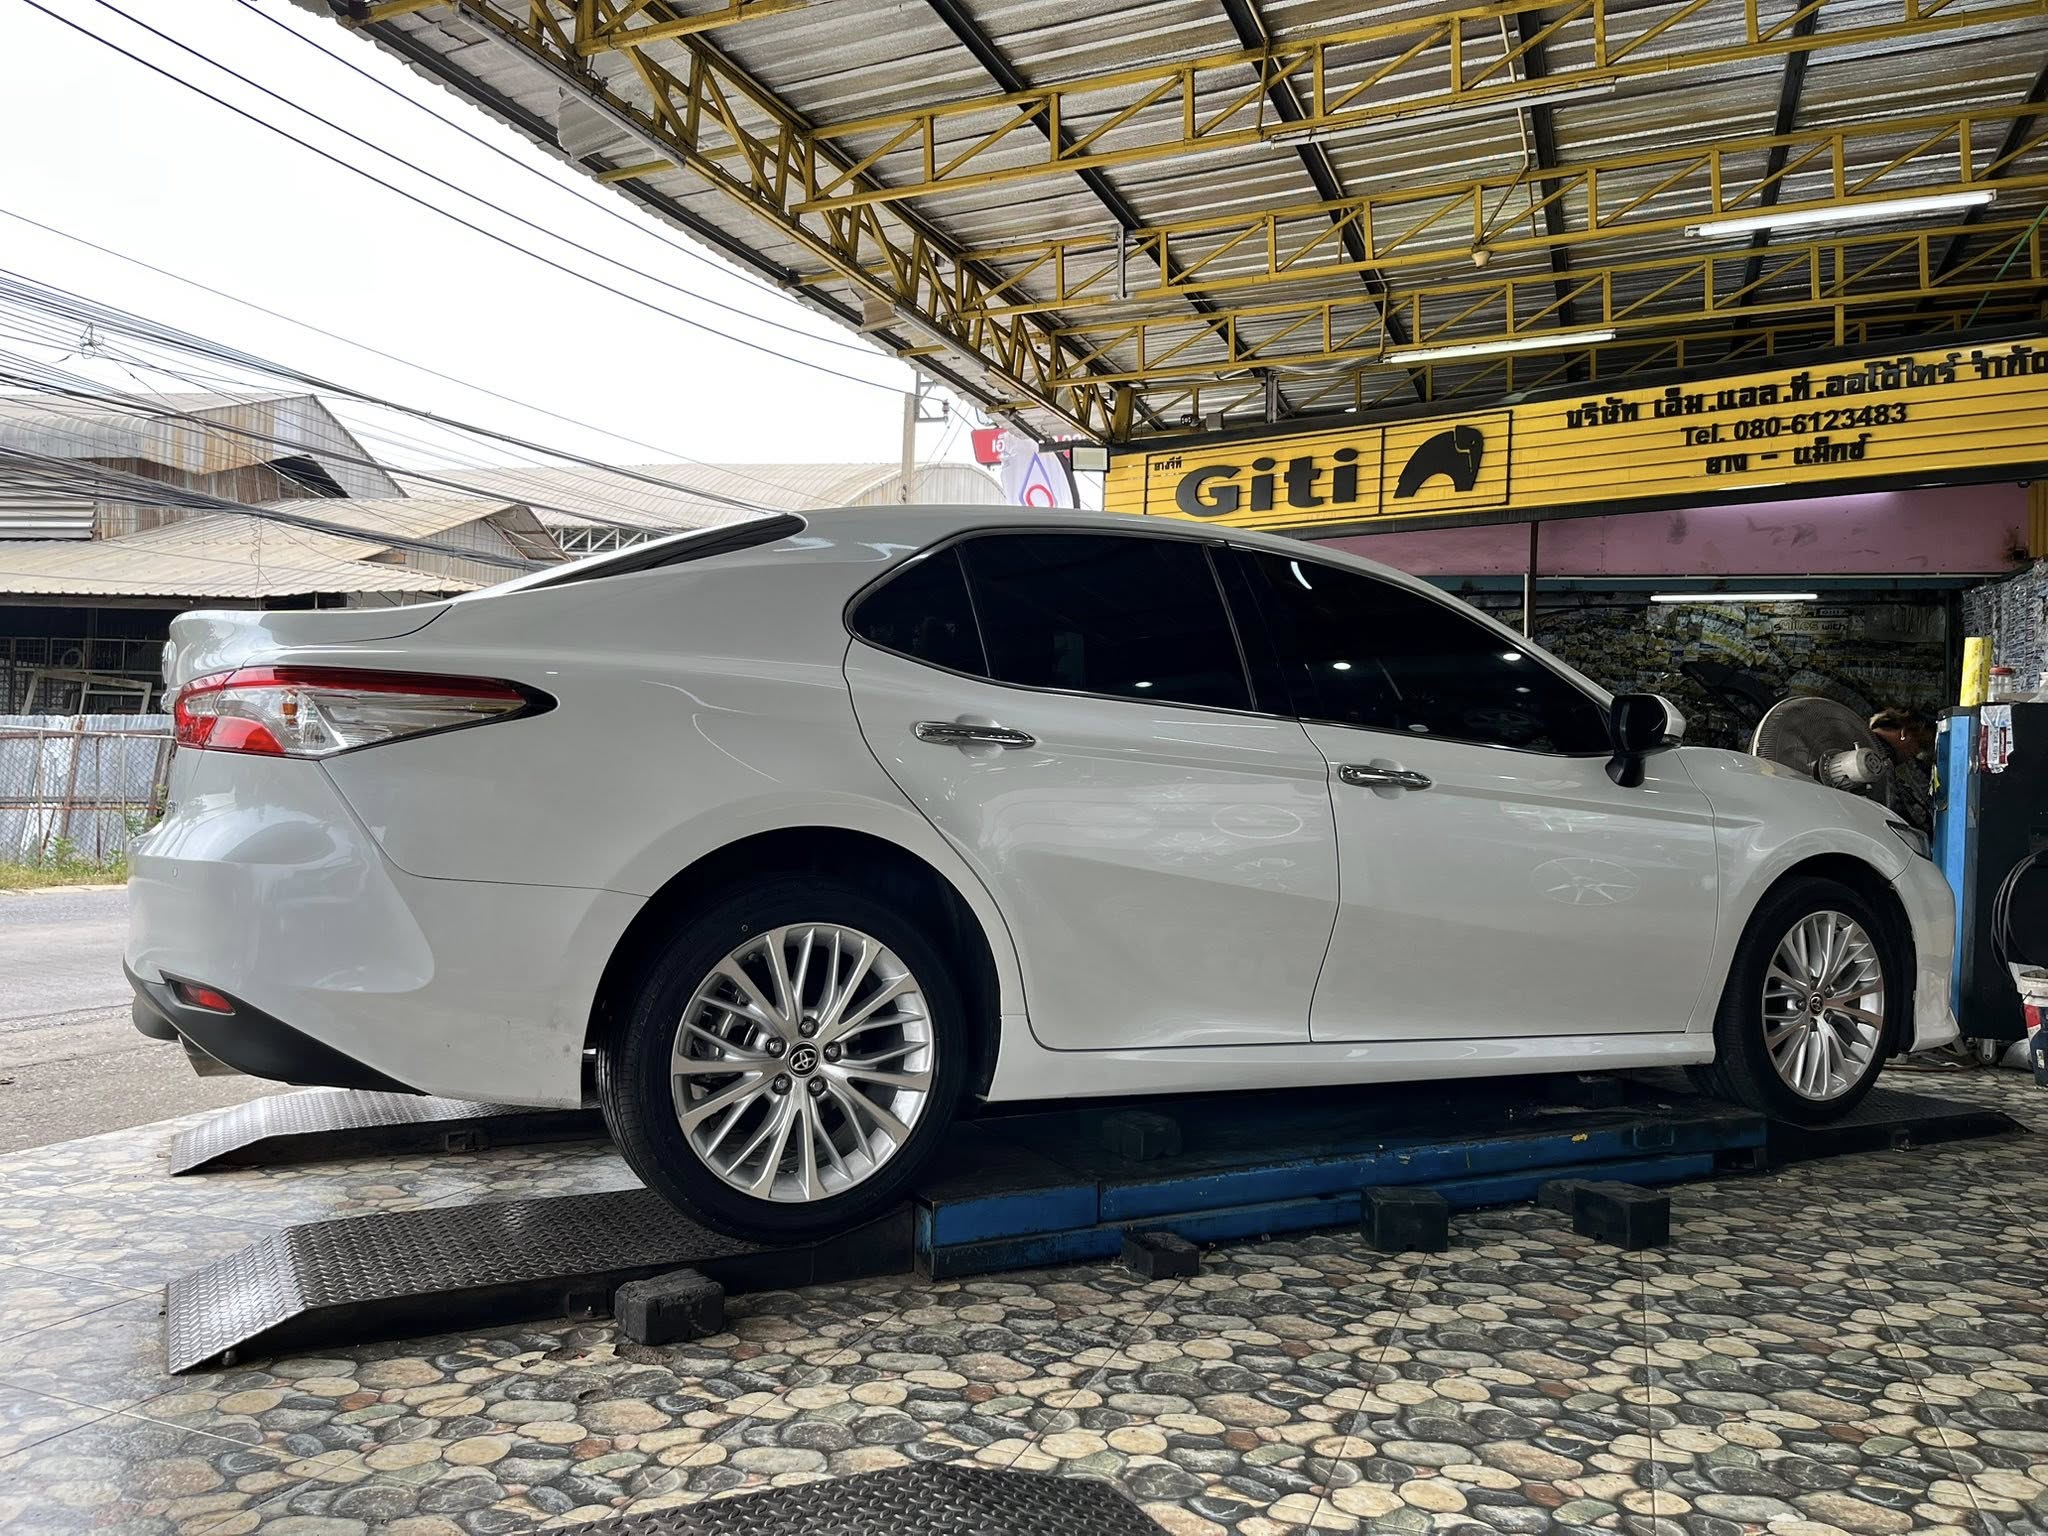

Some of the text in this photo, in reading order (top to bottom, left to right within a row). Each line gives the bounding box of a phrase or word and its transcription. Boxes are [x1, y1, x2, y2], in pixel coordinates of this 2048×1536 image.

[1566, 397, 1639, 429] บริษัท
[1681, 402, 1907, 447] Tel. 080-6123483
[1175, 447, 1359, 518] Giti
[1706, 454, 1748, 474] ยาง
